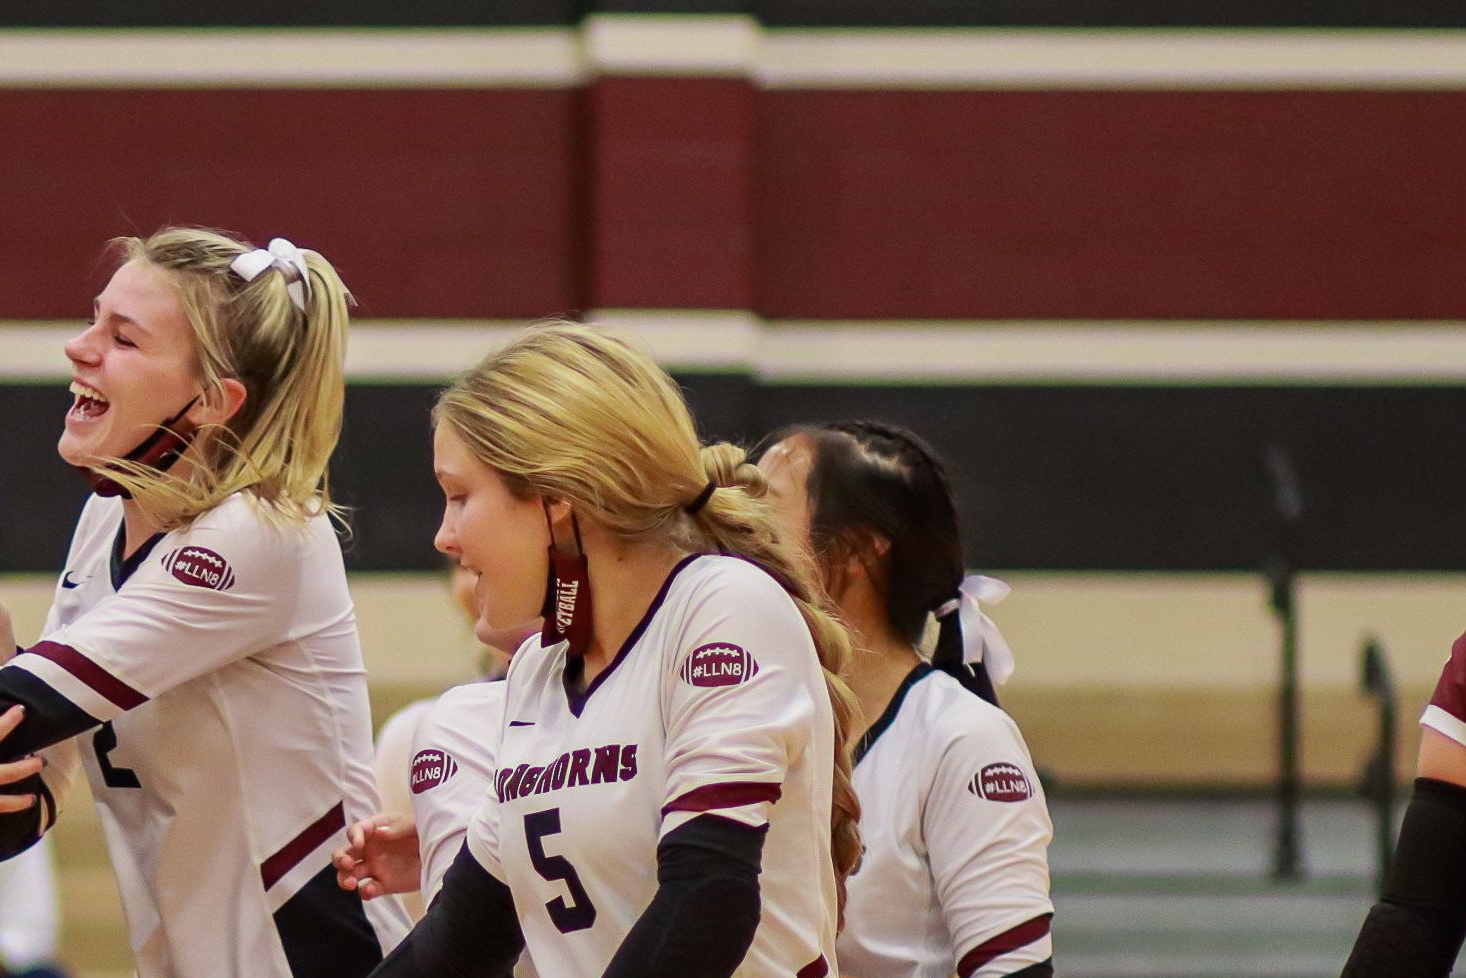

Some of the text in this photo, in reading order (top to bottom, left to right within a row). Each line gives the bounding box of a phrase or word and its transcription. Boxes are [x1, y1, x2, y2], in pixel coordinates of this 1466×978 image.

[175, 561, 219, 586] #LLN8
[692, 662, 742, 678] #LLN8
[493, 744, 639, 804] ONGHORNS
[984, 779, 1027, 794] #LLN8
[523, 806, 597, 935] 5
